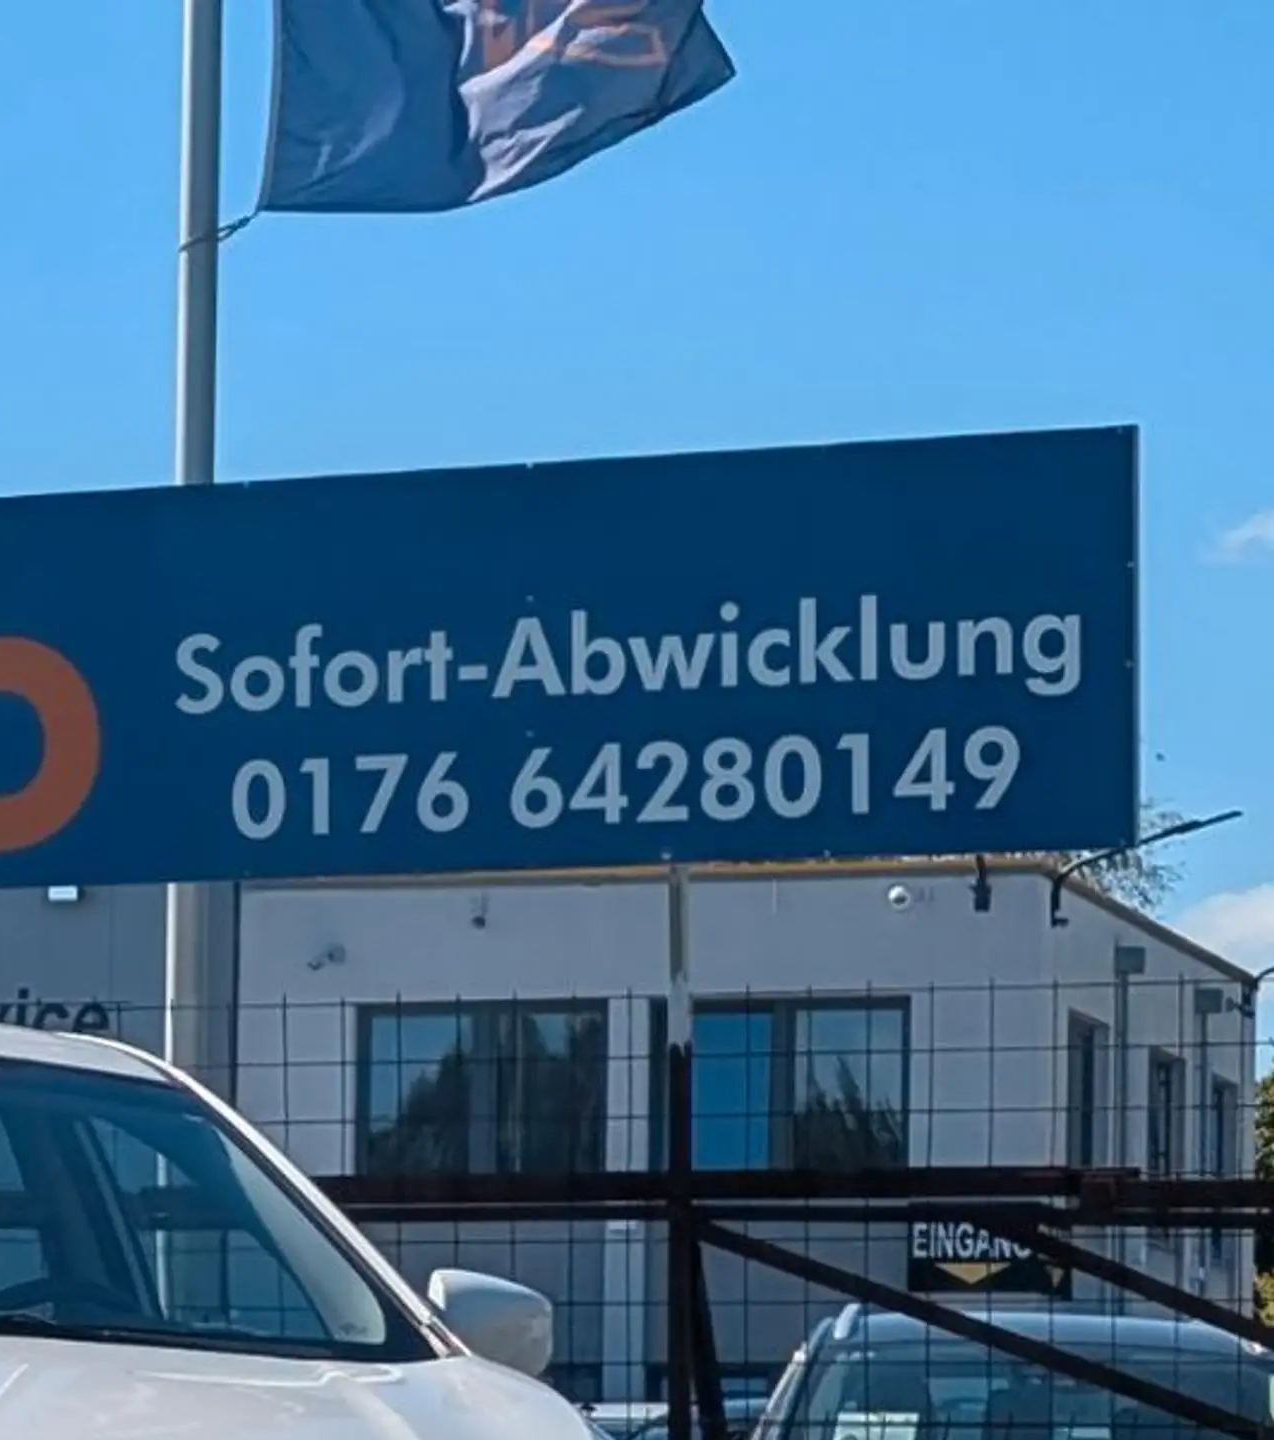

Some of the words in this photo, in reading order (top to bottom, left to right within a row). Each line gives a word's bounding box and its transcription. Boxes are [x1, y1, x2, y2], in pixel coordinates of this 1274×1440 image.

[174, 594, 1082, 715] Sofort-Abwicklung
[231, 752, 469, 840] 0176
[509, 725, 1022, 829] 64280149
